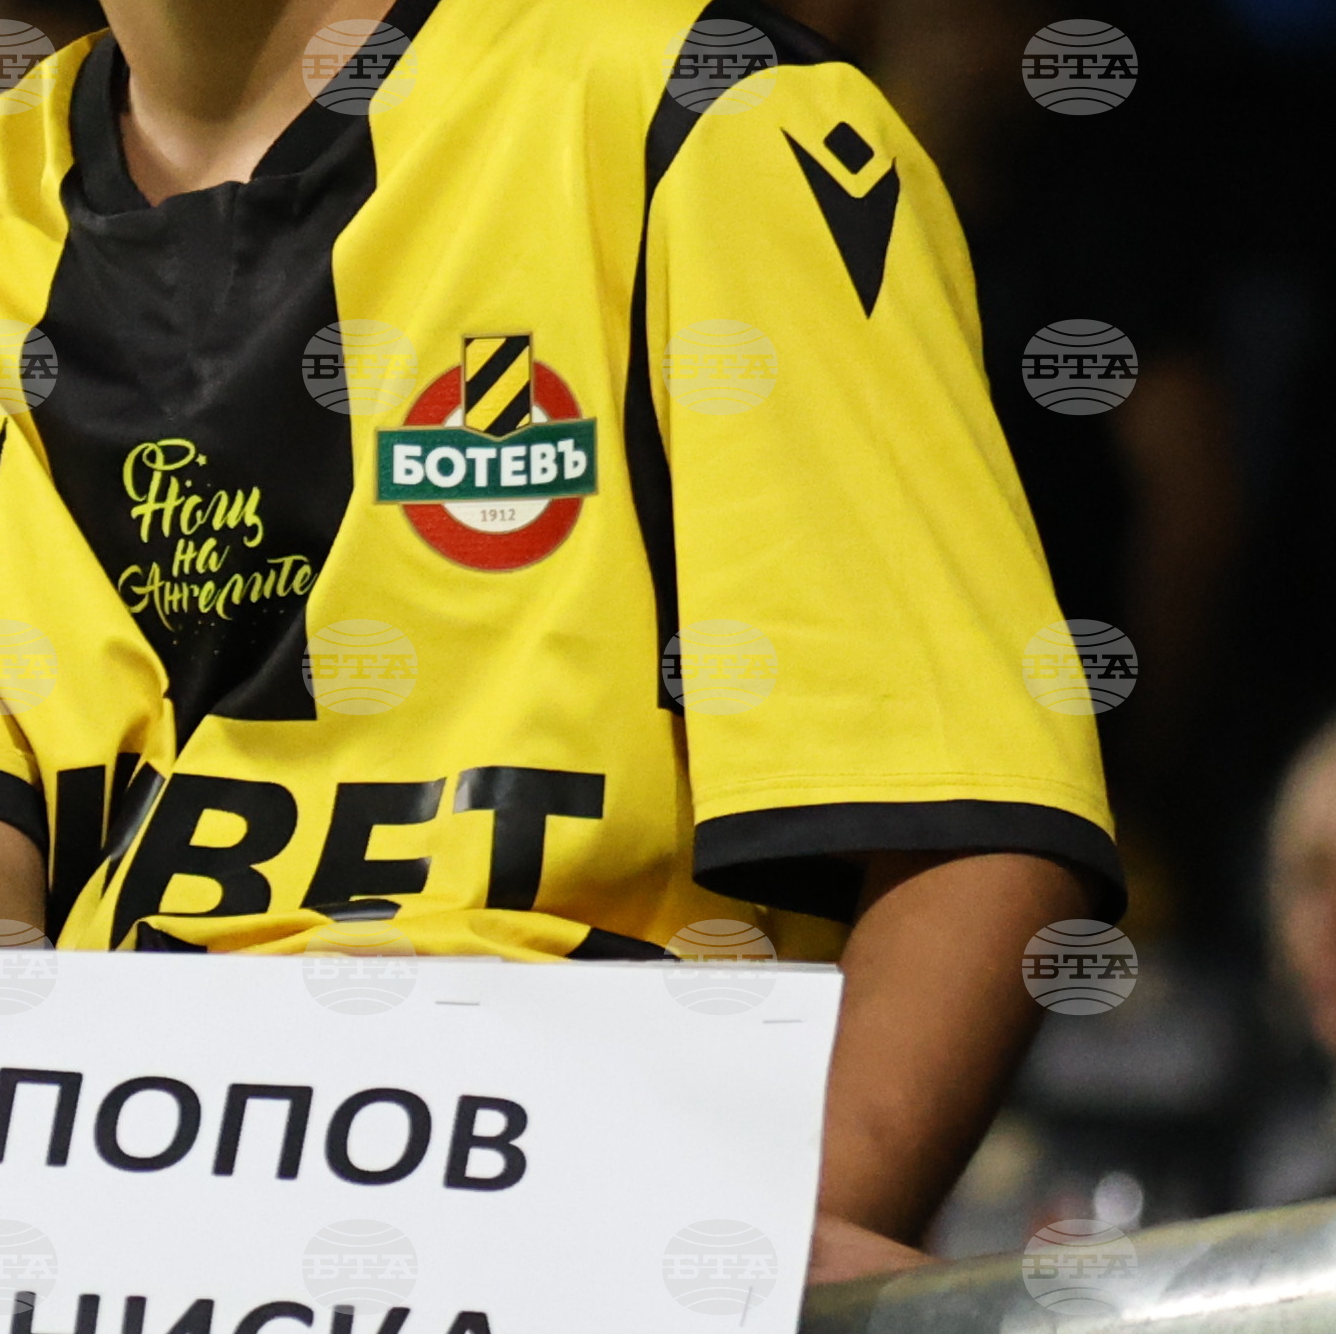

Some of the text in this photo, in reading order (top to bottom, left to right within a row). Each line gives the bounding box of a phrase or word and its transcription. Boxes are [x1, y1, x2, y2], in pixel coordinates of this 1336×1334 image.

[392, 438, 588, 488] БОТЕВЪ
[480, 508, 516, 522] 1912
[172, 538, 230, 577] на
